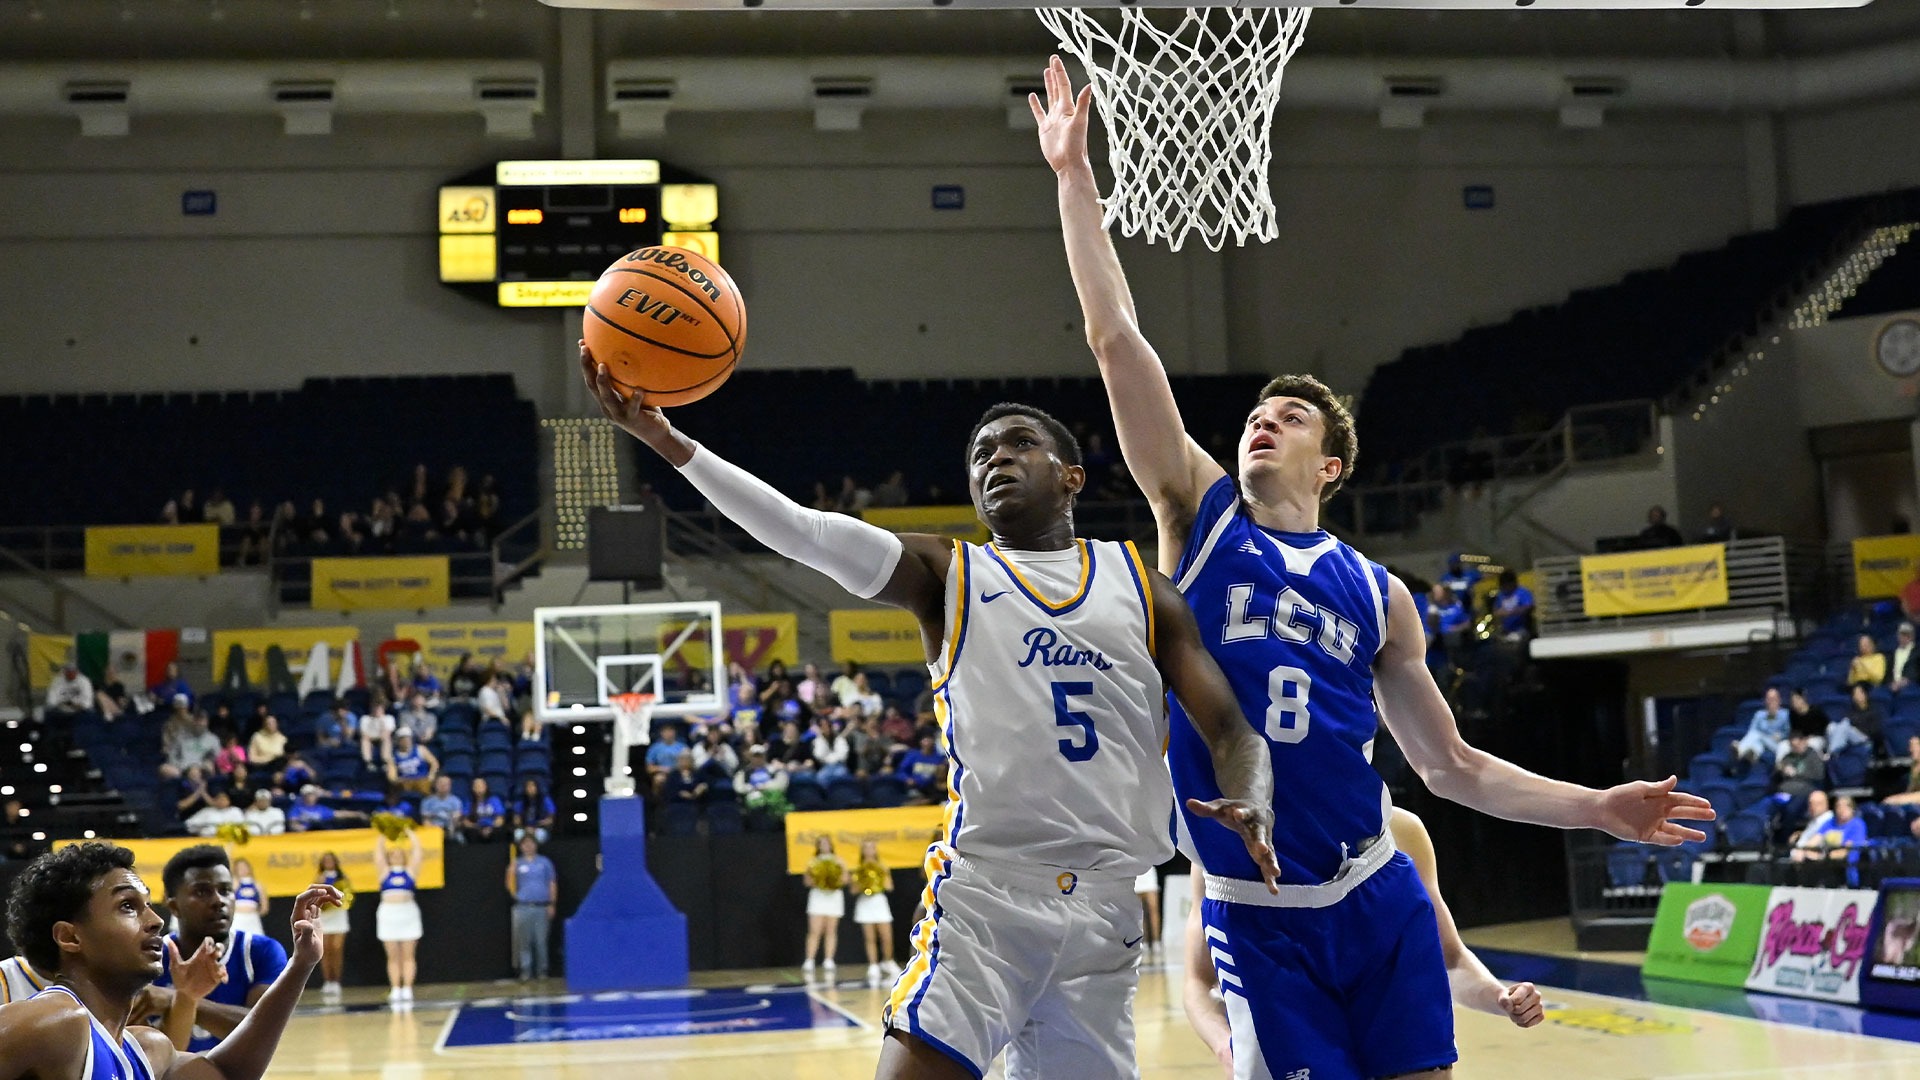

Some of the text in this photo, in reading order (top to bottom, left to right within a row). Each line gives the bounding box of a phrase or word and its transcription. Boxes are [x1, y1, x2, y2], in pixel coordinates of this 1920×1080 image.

[616, 287, 682, 325] EVO
[625, 248, 722, 303] Wilson
[1018, 627, 1113, 671] Rams
[1222, 583, 1360, 667] LCU
[1051, 681, 1100, 762] 5
[1265, 665, 1311, 744] 8
